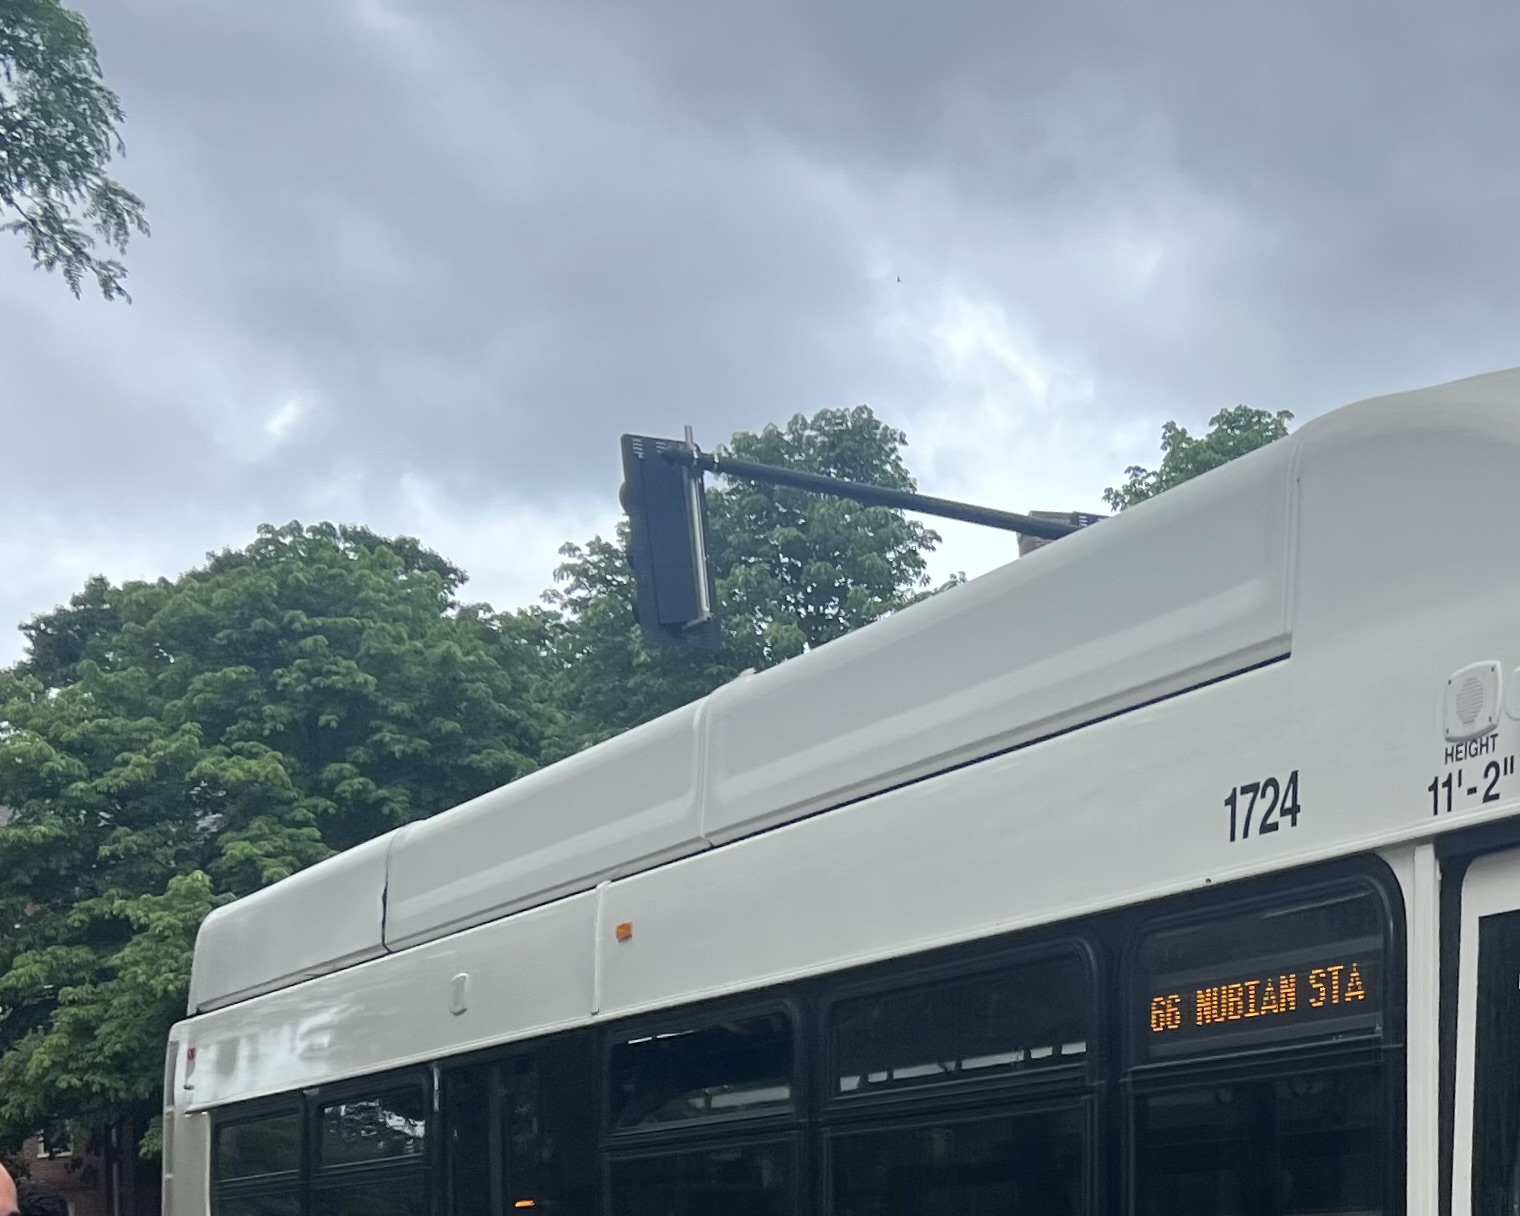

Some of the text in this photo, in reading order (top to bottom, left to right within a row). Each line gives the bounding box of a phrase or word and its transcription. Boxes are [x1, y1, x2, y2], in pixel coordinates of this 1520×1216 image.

[1444, 733, 1499, 765] HEIGHT
[1224, 770, 1301, 843] 1724
[1151, 963, 1365, 1032] 66 NUBIAN STA
